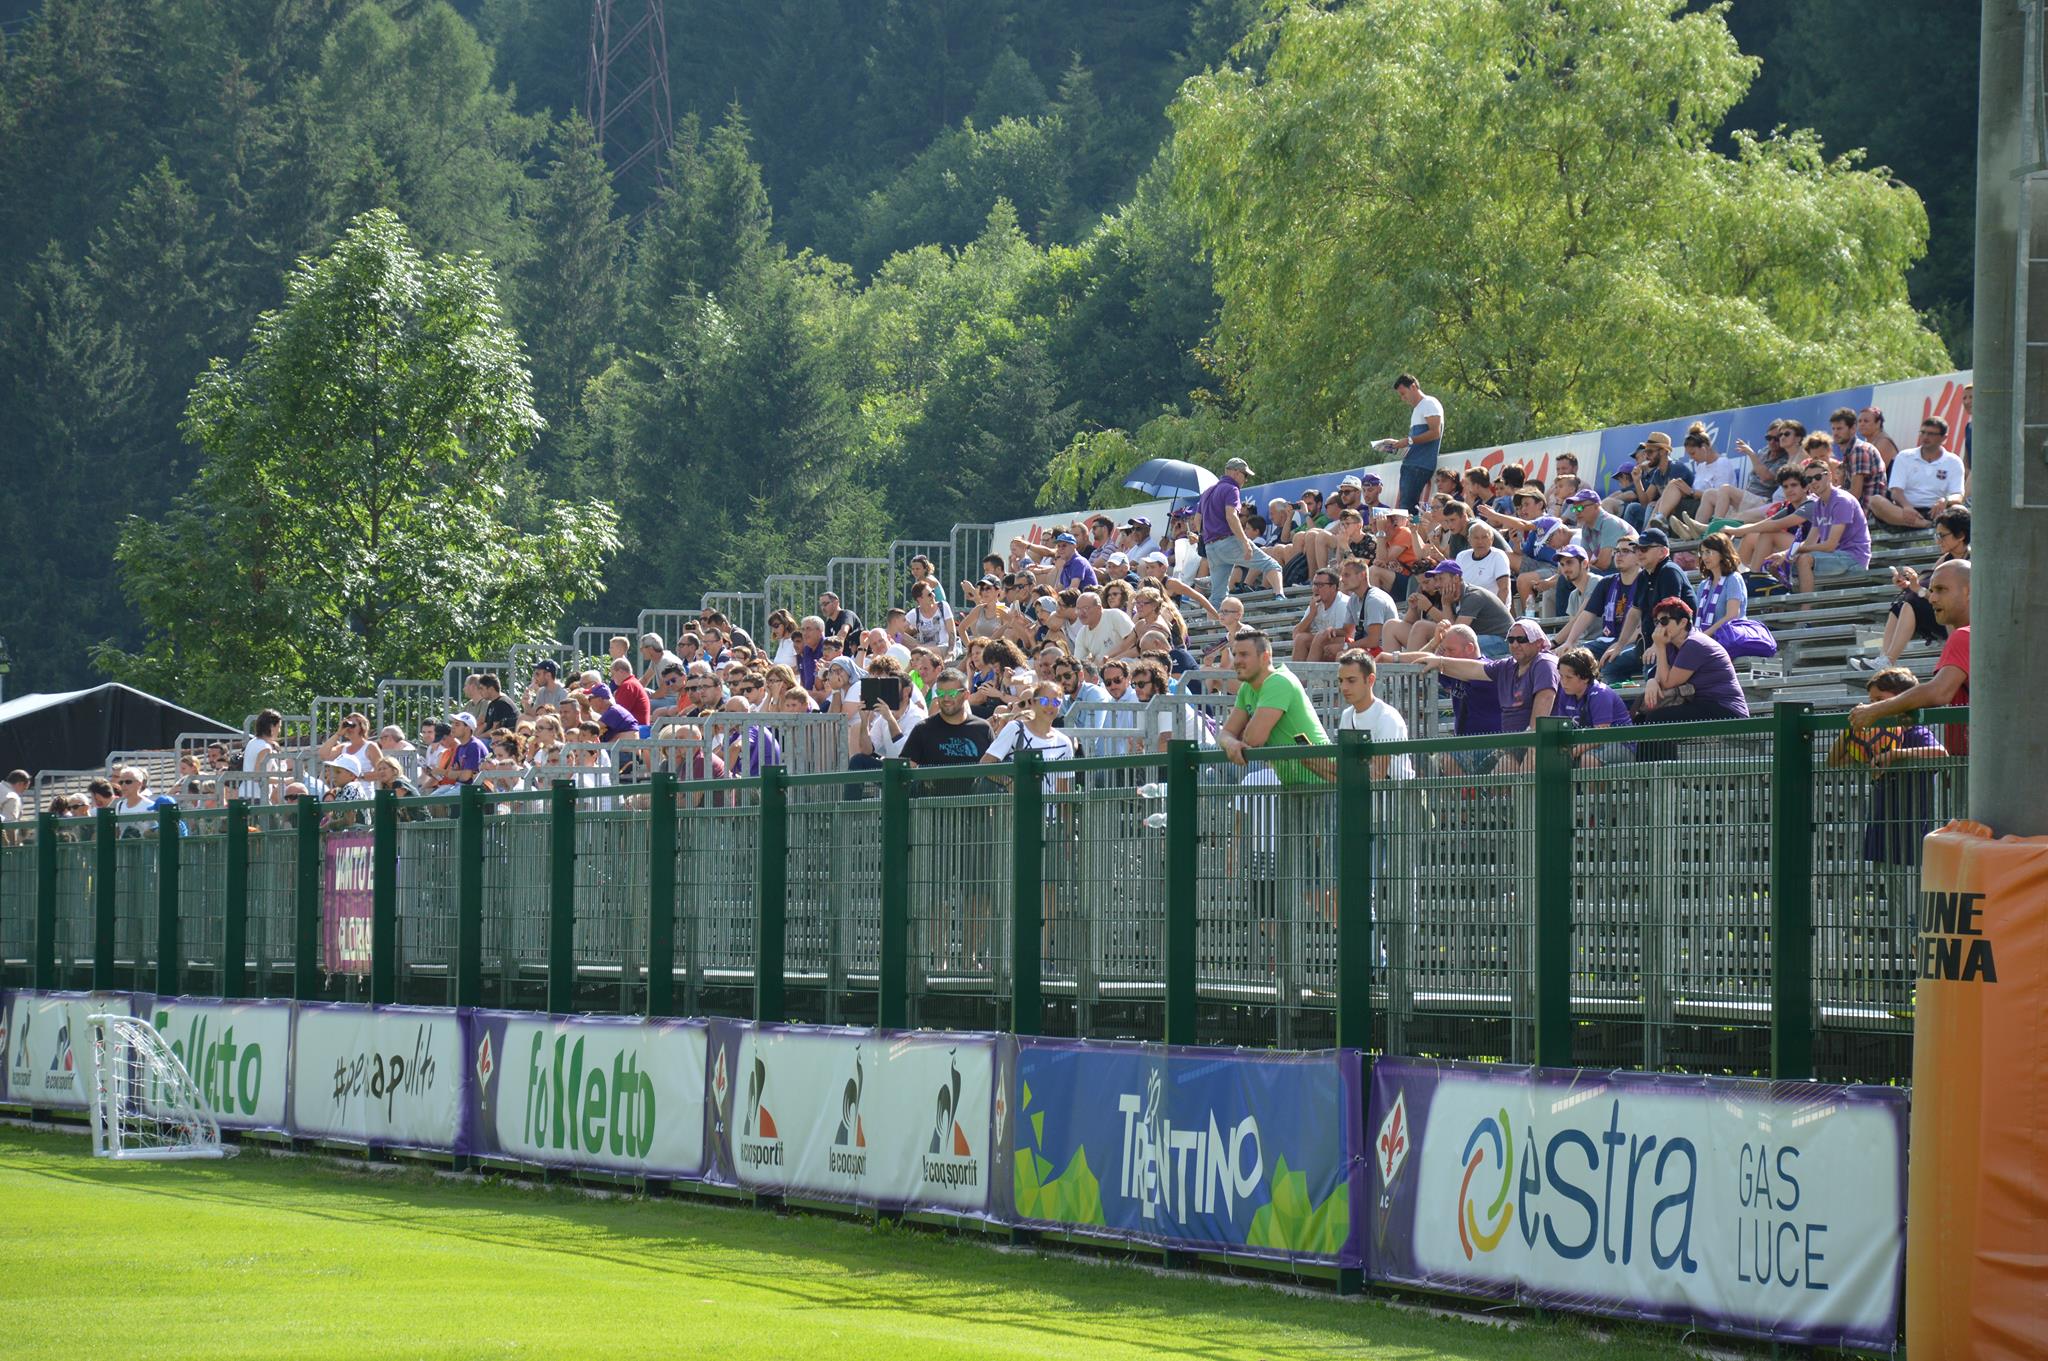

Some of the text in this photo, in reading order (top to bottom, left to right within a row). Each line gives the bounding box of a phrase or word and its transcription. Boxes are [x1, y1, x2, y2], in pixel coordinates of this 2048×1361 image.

[524, 1030, 656, 1159] folletto
[1119, 1093, 1263, 1224] TRENTINO
[1518, 1099, 1698, 1275] estra
[1738, 1142, 1801, 1212] GAS
[1738, 1217, 1829, 1291] LUCE
